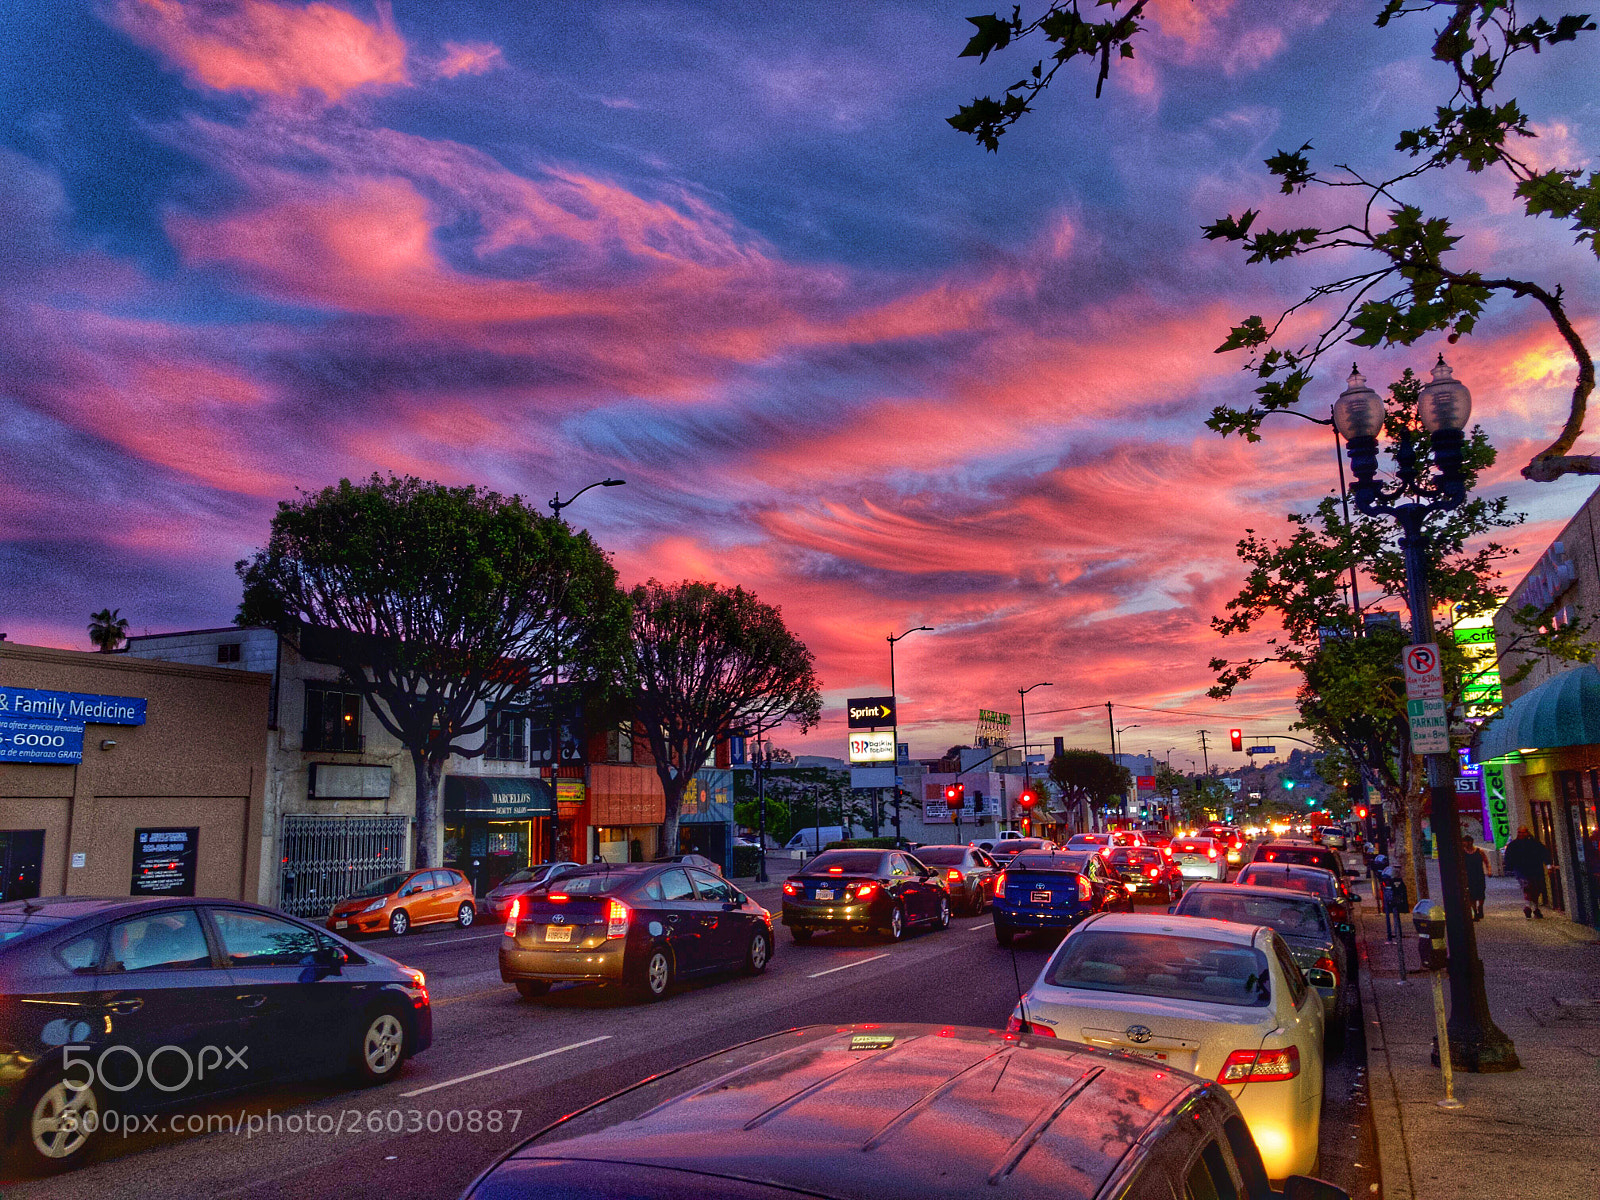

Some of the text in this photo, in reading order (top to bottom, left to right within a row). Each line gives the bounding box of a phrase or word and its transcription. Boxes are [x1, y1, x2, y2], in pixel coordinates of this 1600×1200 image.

[14, 695, 66, 719] Family
[69, 699, 135, 719] Medicine
[850, 706, 880, 720] Sprint
[8, 720, 28, 731] ofrece
[28, 722, 54, 732] servicios
[54, 724, 84, 733] prenatales
[1411, 716, 1445, 729] PARKING
[7, 748, 18, 757] de
[19, 749, 57, 758] embarazo
[57, 750, 83, 759] GRATIS
[492, 793, 531, 804] MARCELLO'S
[1486, 769, 1510, 838] cricket
[495, 806, 528, 815] BEAUTY SALON
